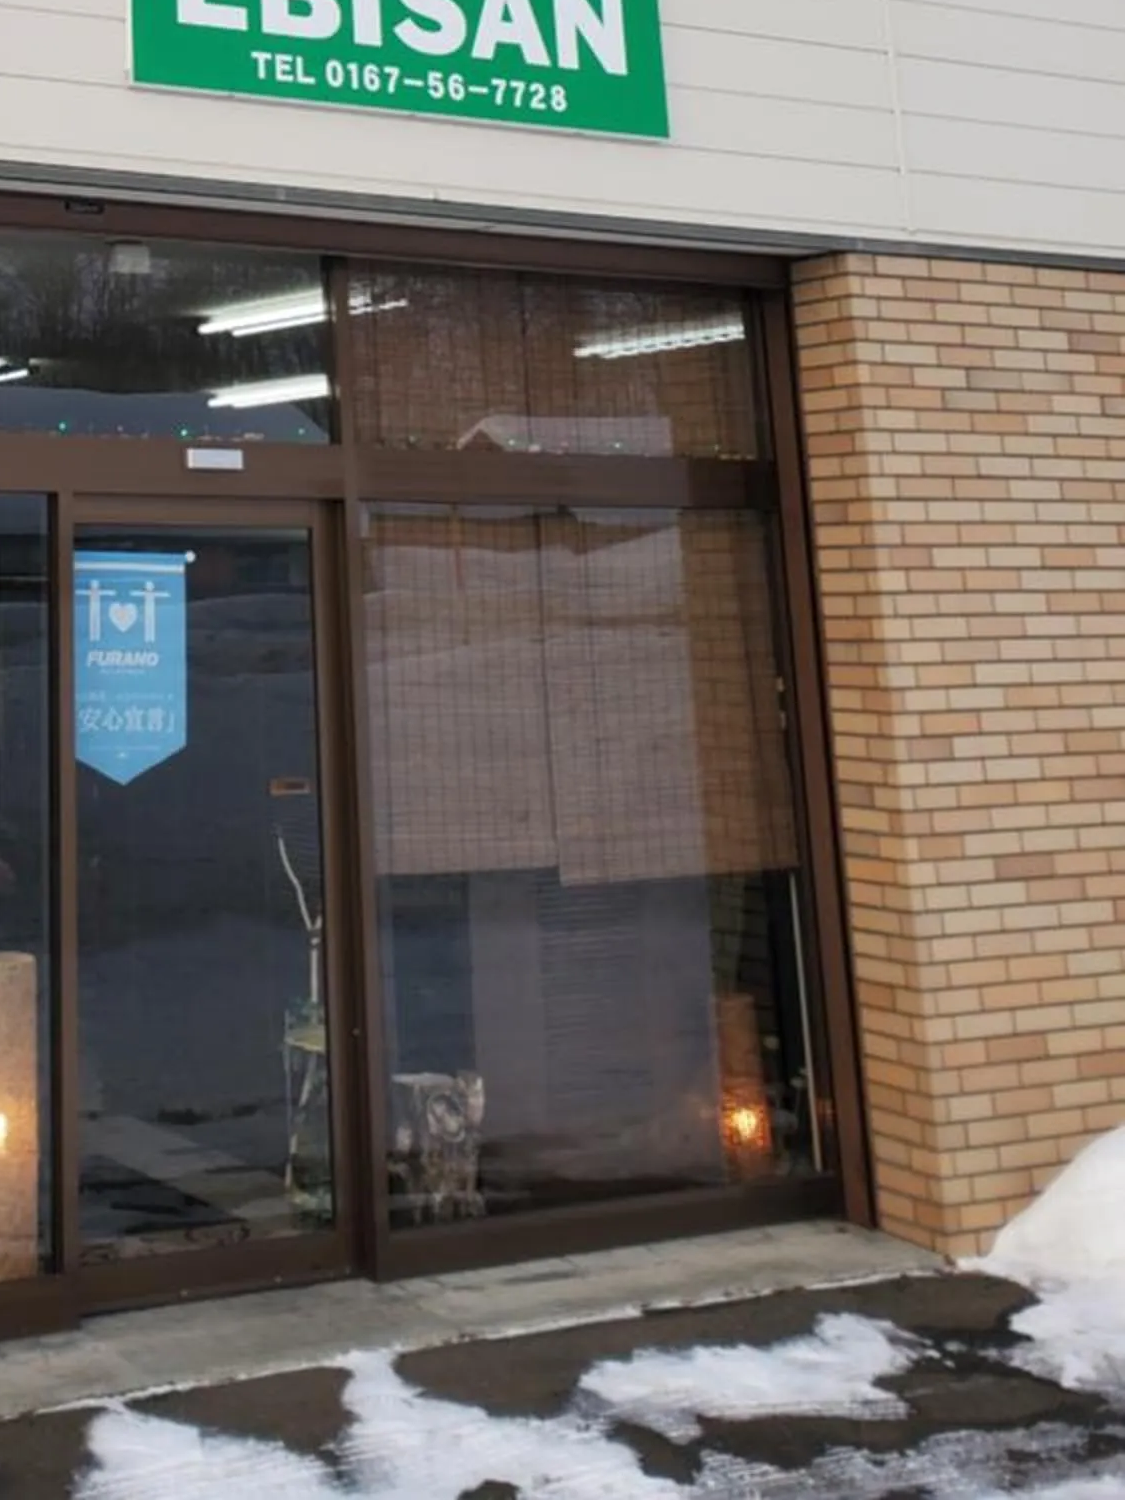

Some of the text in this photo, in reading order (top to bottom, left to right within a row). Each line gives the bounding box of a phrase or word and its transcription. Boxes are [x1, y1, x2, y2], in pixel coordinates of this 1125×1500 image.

[251, 51, 568, 112] TEL 0167-56-7728
[86, 650, 159, 667] FURANO
